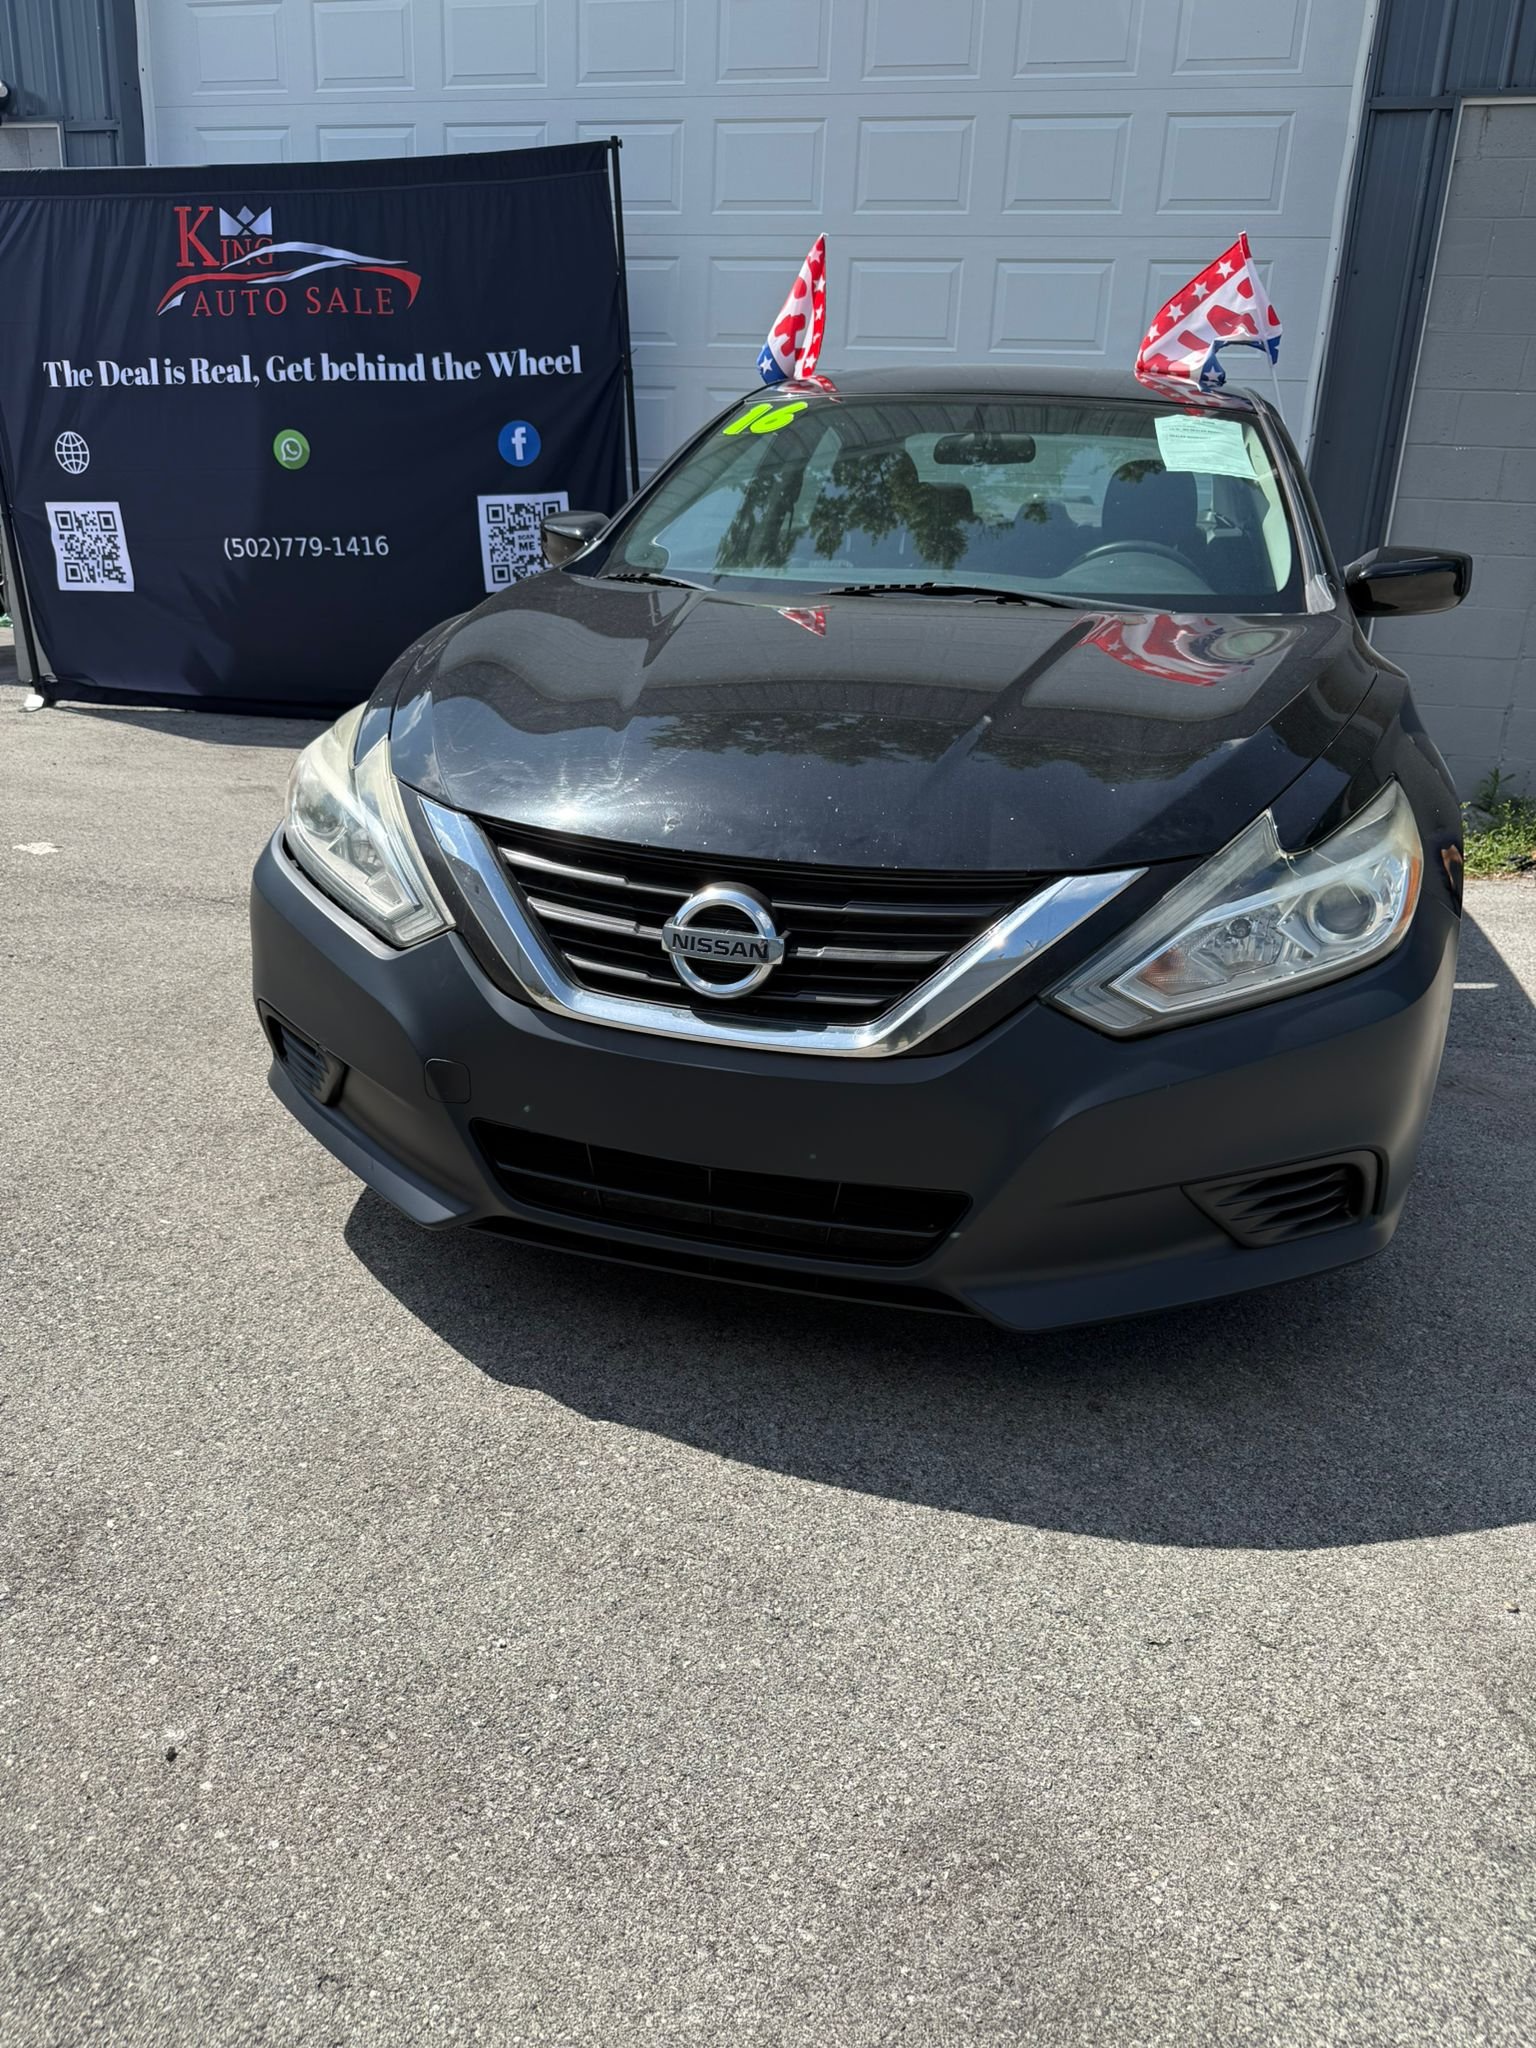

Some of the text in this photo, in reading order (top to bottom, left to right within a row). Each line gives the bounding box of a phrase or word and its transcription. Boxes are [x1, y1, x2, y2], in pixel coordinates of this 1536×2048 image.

[192, 286, 394, 317] AUTO SALE
[43, 345, 583, 388] The Deal is Real, Get behind the Wheel
[722, 401, 809, 435] 16
[223, 535, 390, 561] (502)779-1416
[518, 541, 536, 551] ME
[671, 933, 769, 960] NISSAN
